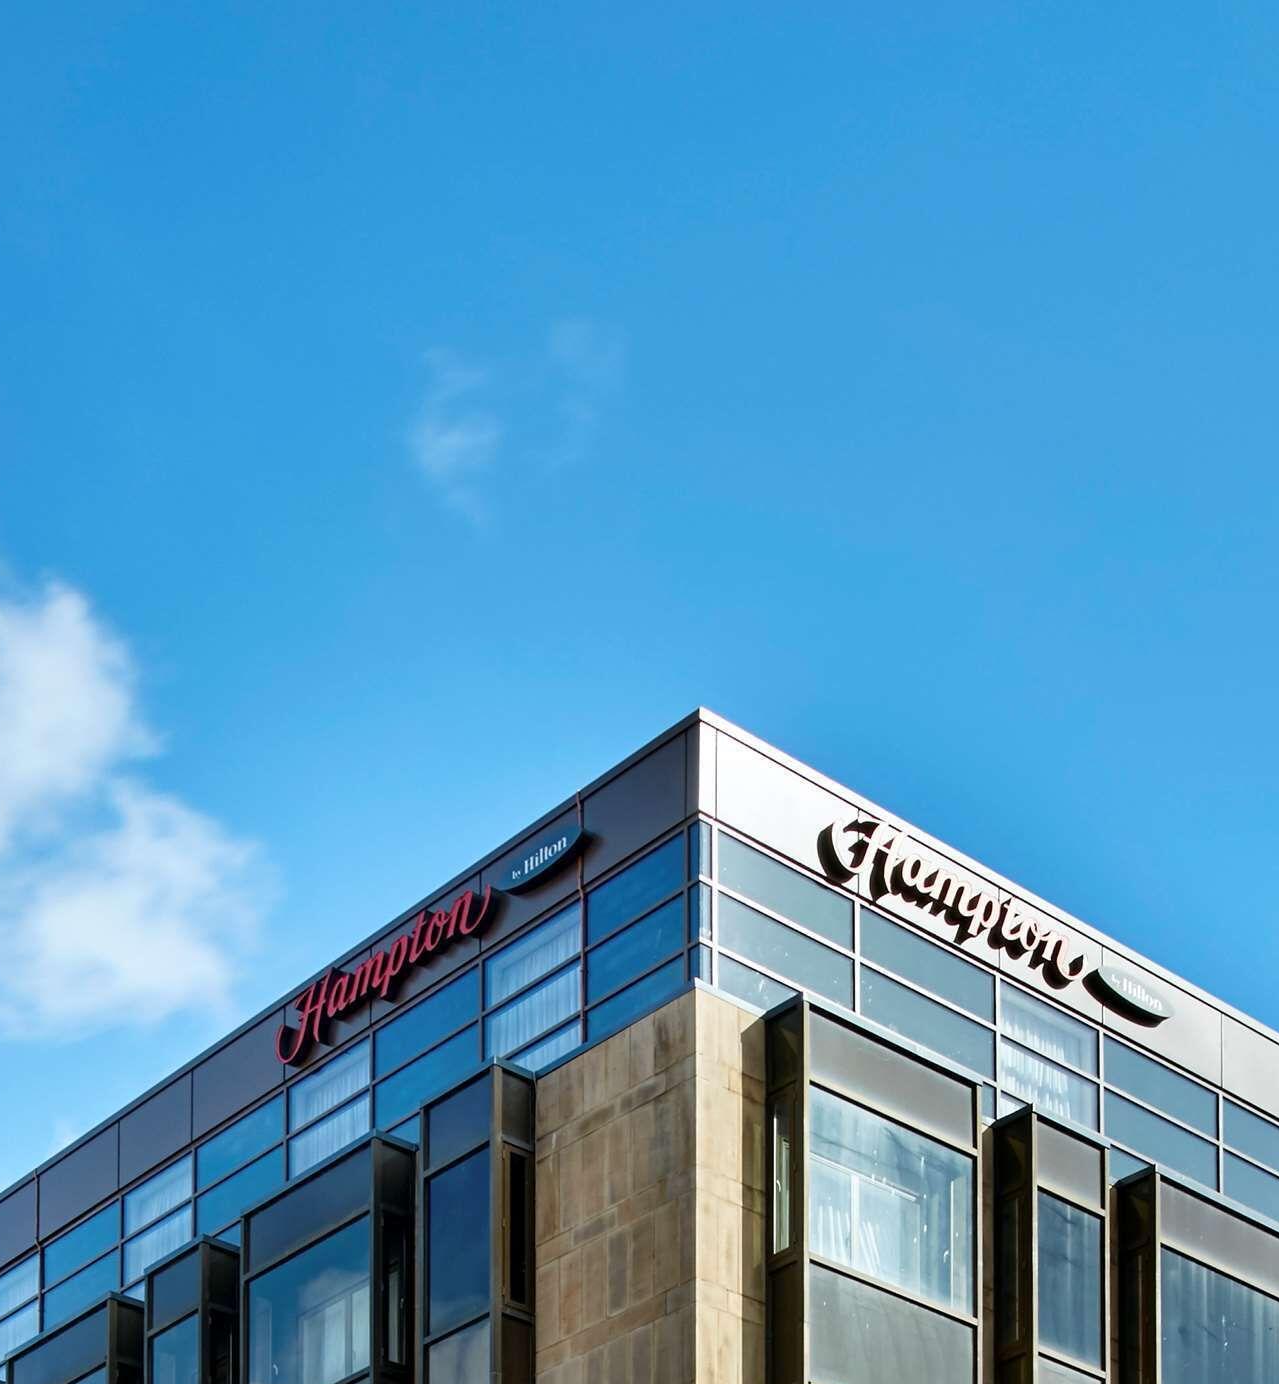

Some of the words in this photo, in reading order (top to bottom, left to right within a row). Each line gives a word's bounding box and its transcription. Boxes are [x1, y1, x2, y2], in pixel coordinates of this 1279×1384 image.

[274, 883, 492, 1065] Hampton
[511, 868, 522, 881] by
[523, 835, 568, 875] Hilton
[830, 815, 1089, 984] Hampton
[1122, 977, 1163, 1011] Hilton
